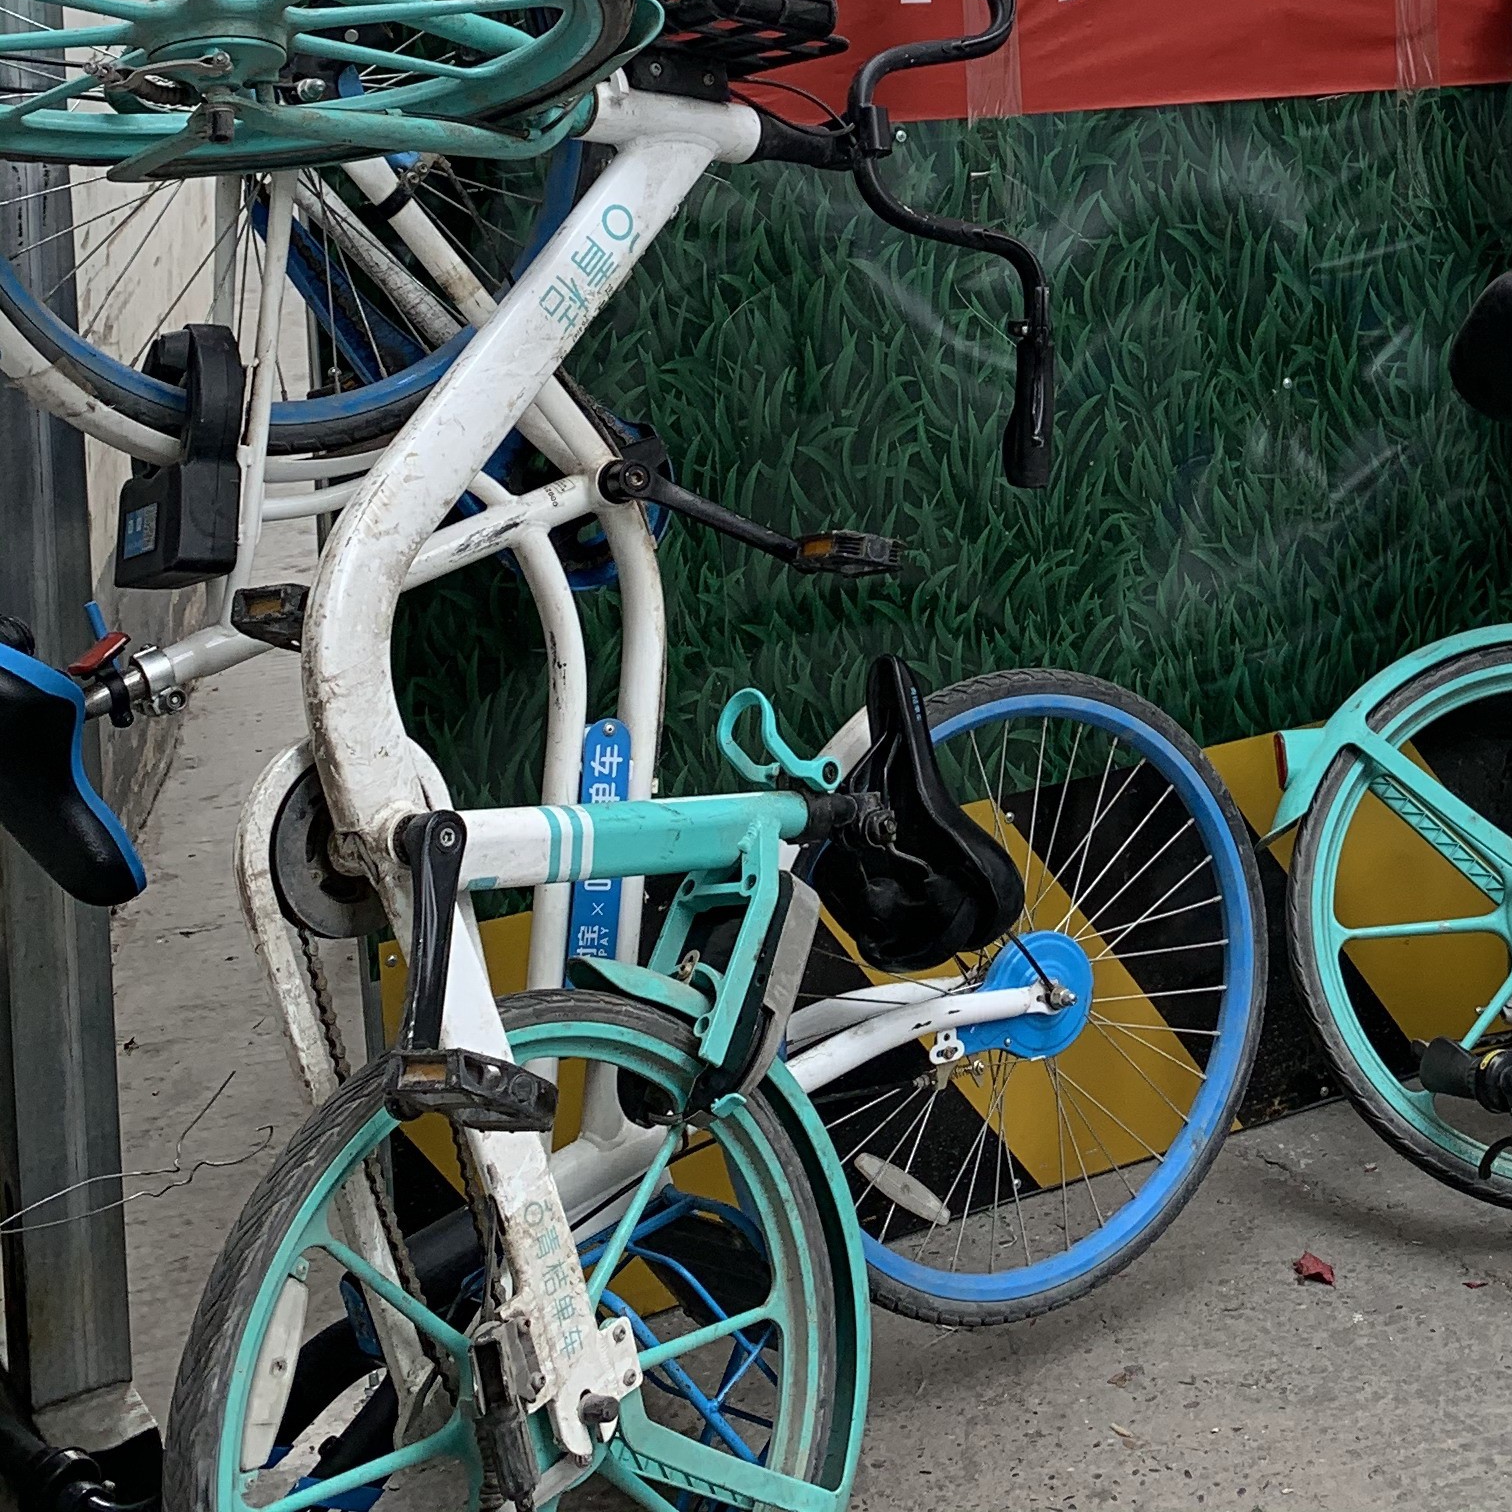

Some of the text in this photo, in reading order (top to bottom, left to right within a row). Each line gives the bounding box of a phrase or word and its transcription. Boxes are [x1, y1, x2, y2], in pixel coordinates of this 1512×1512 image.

[539, 235, 620, 335] 青桔
[536, 1225, 584, 1361] 青桔单车
